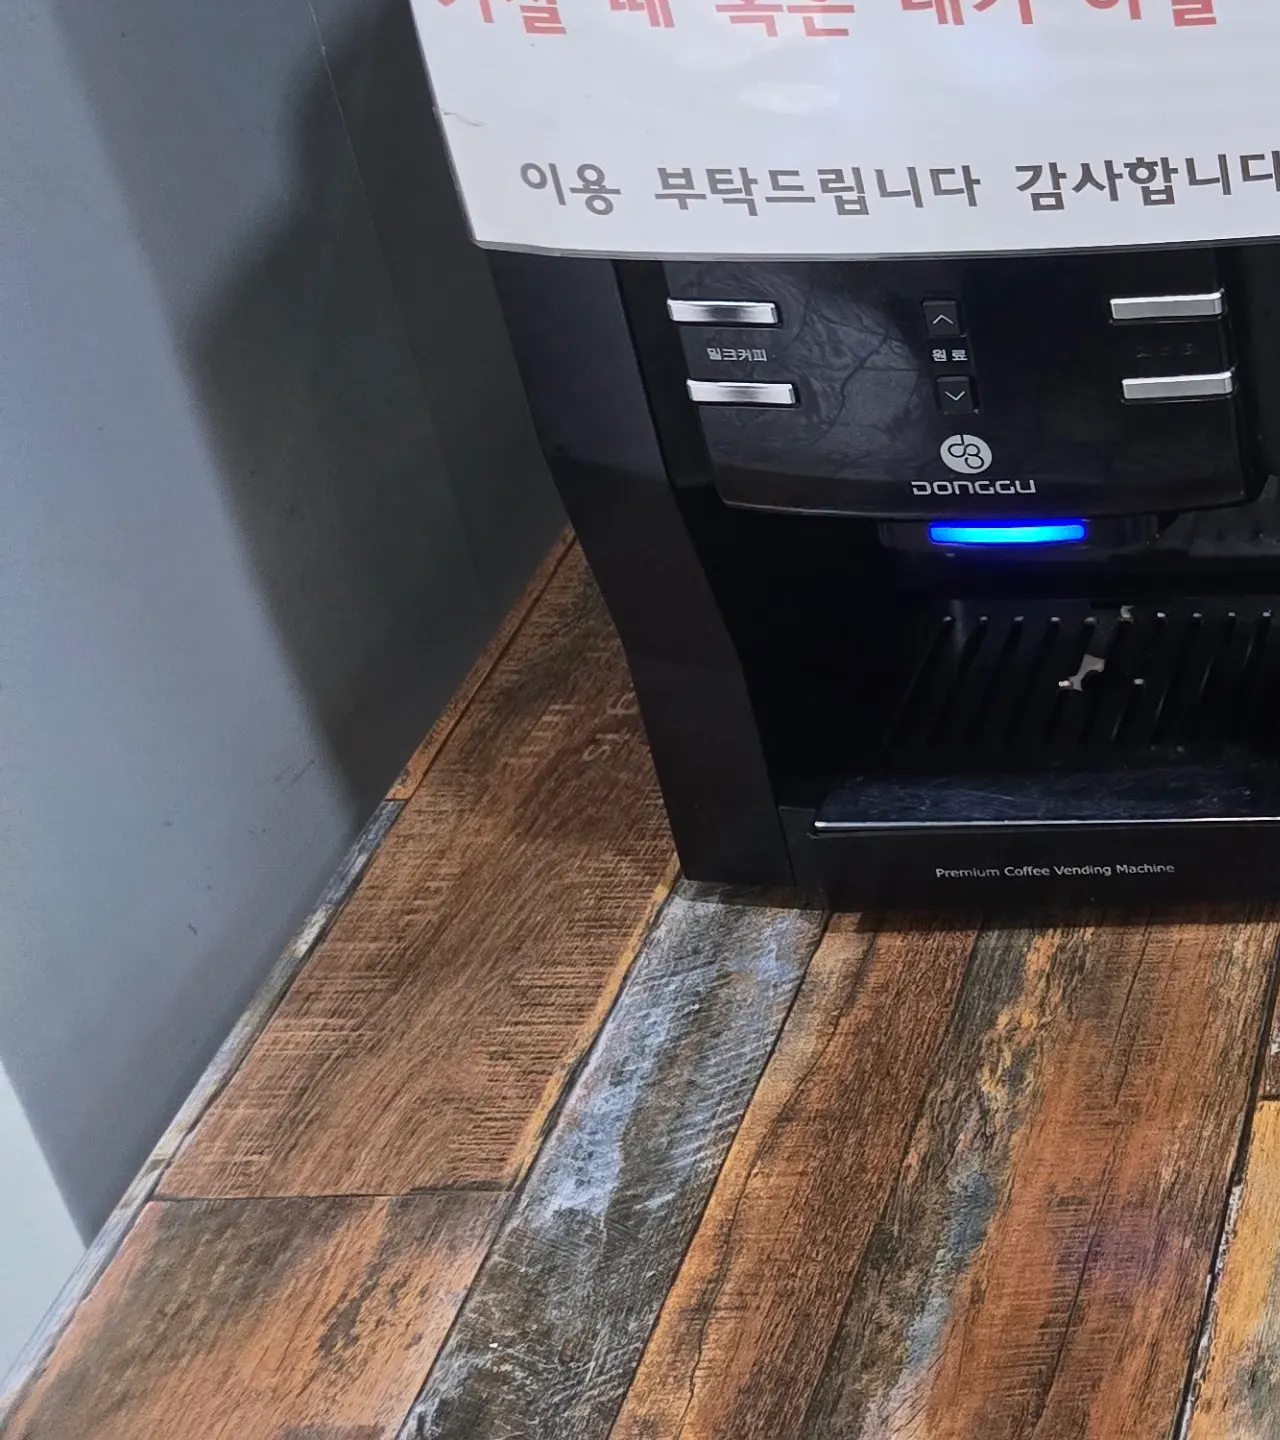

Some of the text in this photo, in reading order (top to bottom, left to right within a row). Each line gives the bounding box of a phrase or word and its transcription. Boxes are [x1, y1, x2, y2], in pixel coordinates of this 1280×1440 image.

[520, 162, 622, 217] 이용
[655, 164, 983, 218] 부탁드립니다
[911, 479, 1037, 496] DONGGU
[935, 863, 1175, 878] Premium Coffee Vending Machine
